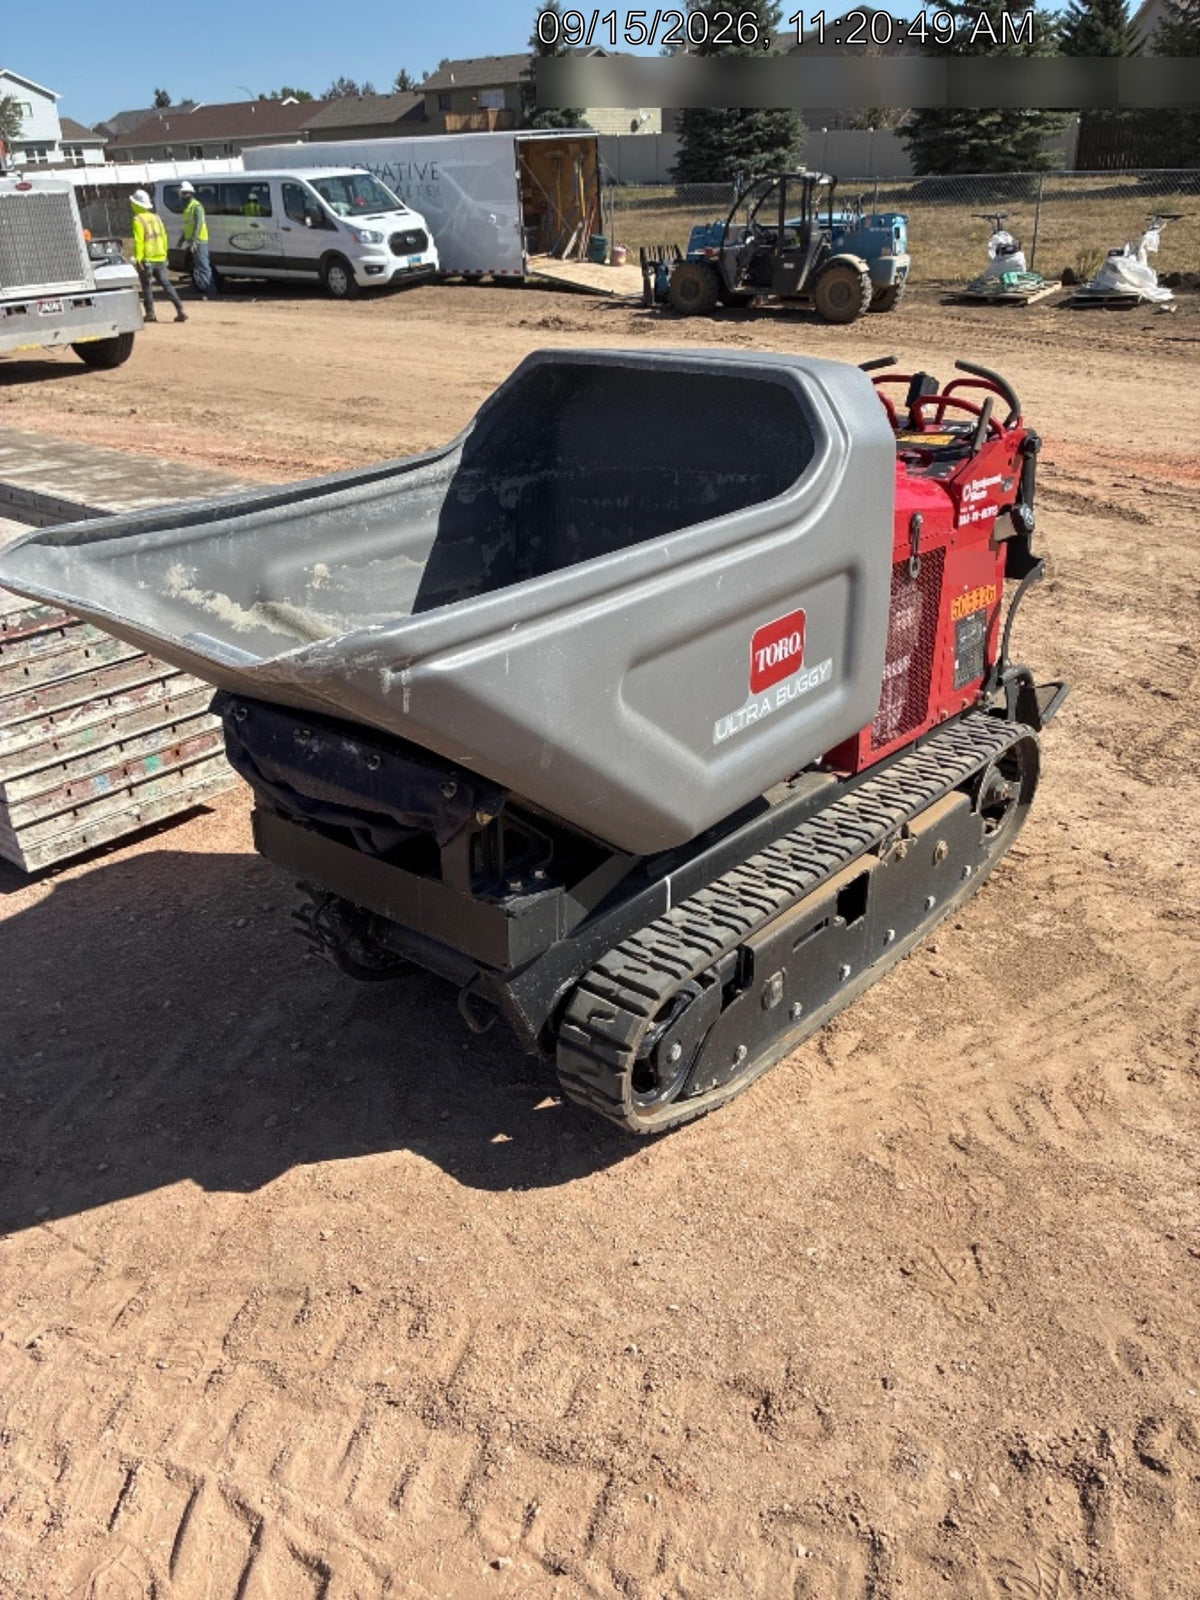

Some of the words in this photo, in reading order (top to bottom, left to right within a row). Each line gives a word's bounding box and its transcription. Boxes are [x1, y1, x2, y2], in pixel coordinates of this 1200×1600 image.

[755, 632, 802, 673] TORO
[714, 698, 771, 740] ULTRA
[776, 658, 831, 707] BUGGY
